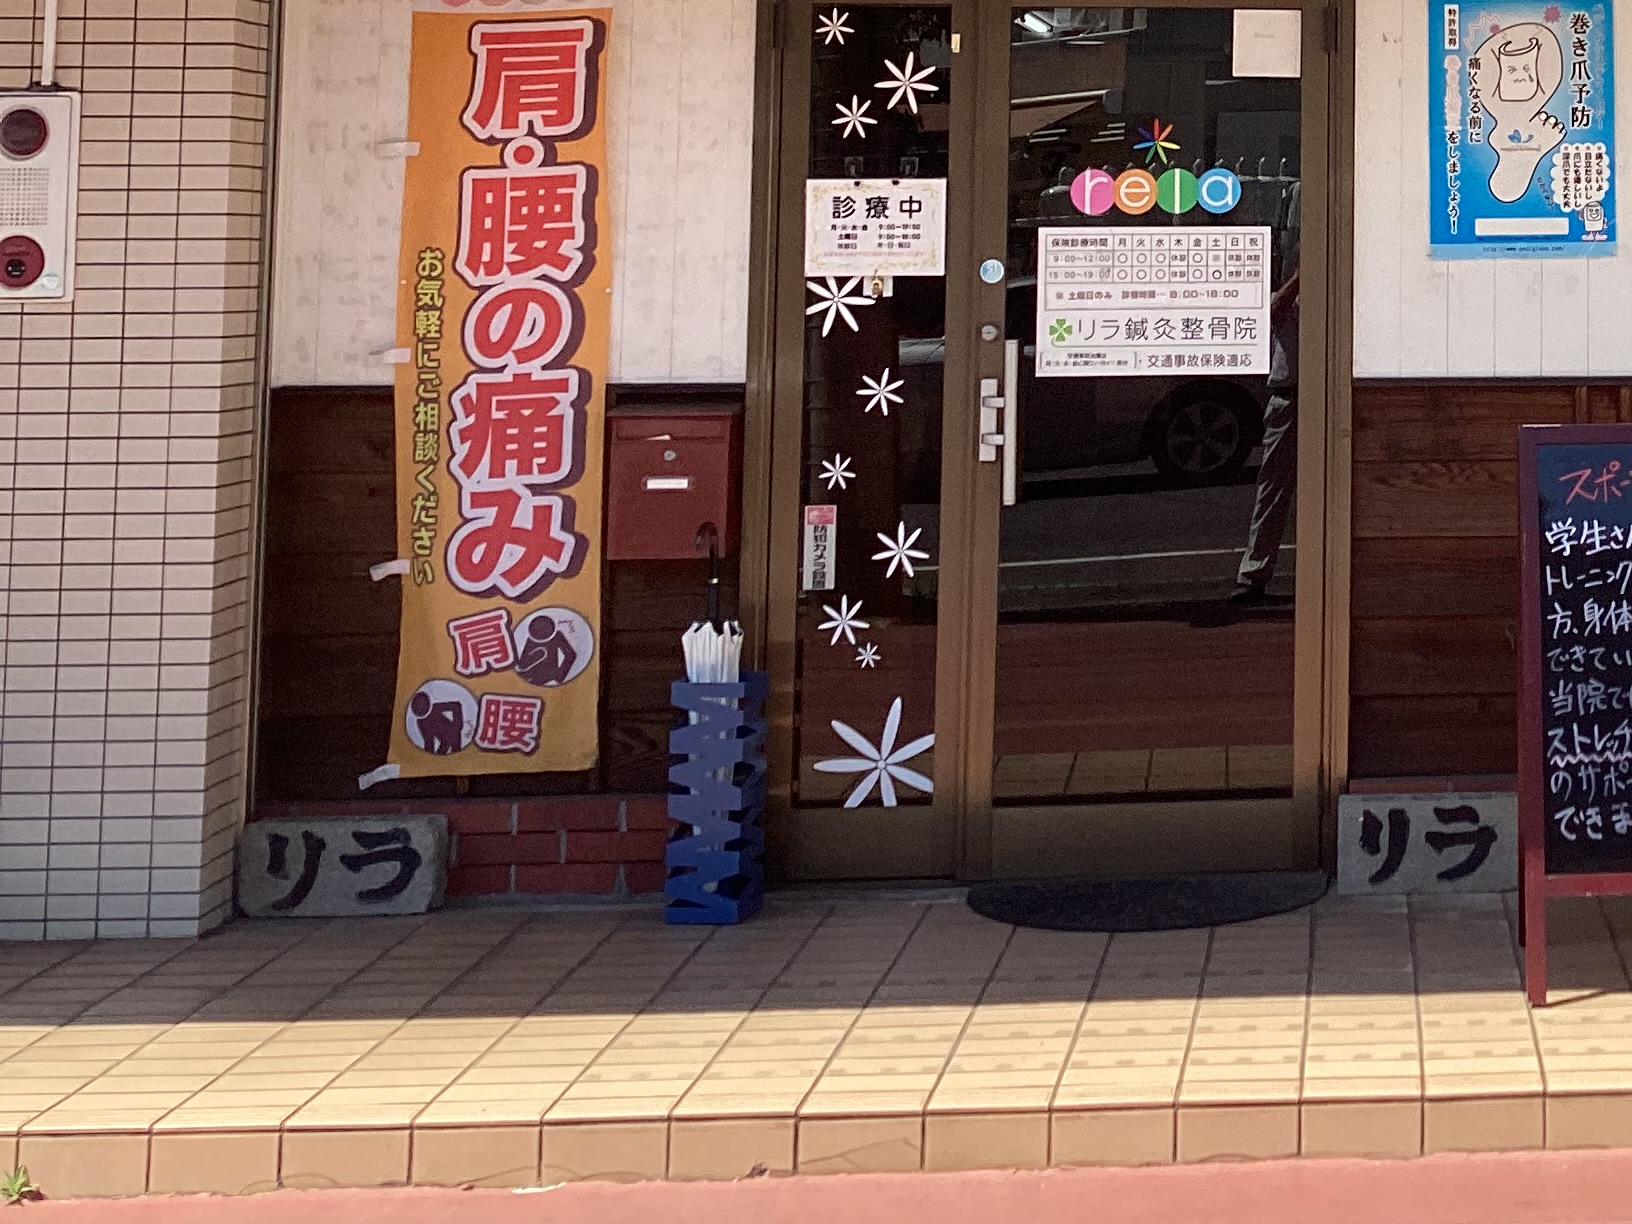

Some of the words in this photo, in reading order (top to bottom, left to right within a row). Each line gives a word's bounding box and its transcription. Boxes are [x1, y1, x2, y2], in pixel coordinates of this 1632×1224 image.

[1468, 57, 1483, 143] 痛くなる前に
[1569, 13, 1592, 129] 巻き爪予防
[832, 195, 922, 219] 診療中
[1084, 169, 1234, 215] rela
[448, 19, 602, 598] 肩・腰の痛み
[1079, 317, 1257, 341] リラ鍼灸整骨院
[411, 248, 445, 586] お気軽にご相談ください
[449, 611, 513, 674] 肩
[477, 694, 542, 753] 腰
[266, 827, 423, 911] リラ
[1358, 803, 1498, 886] リラ
